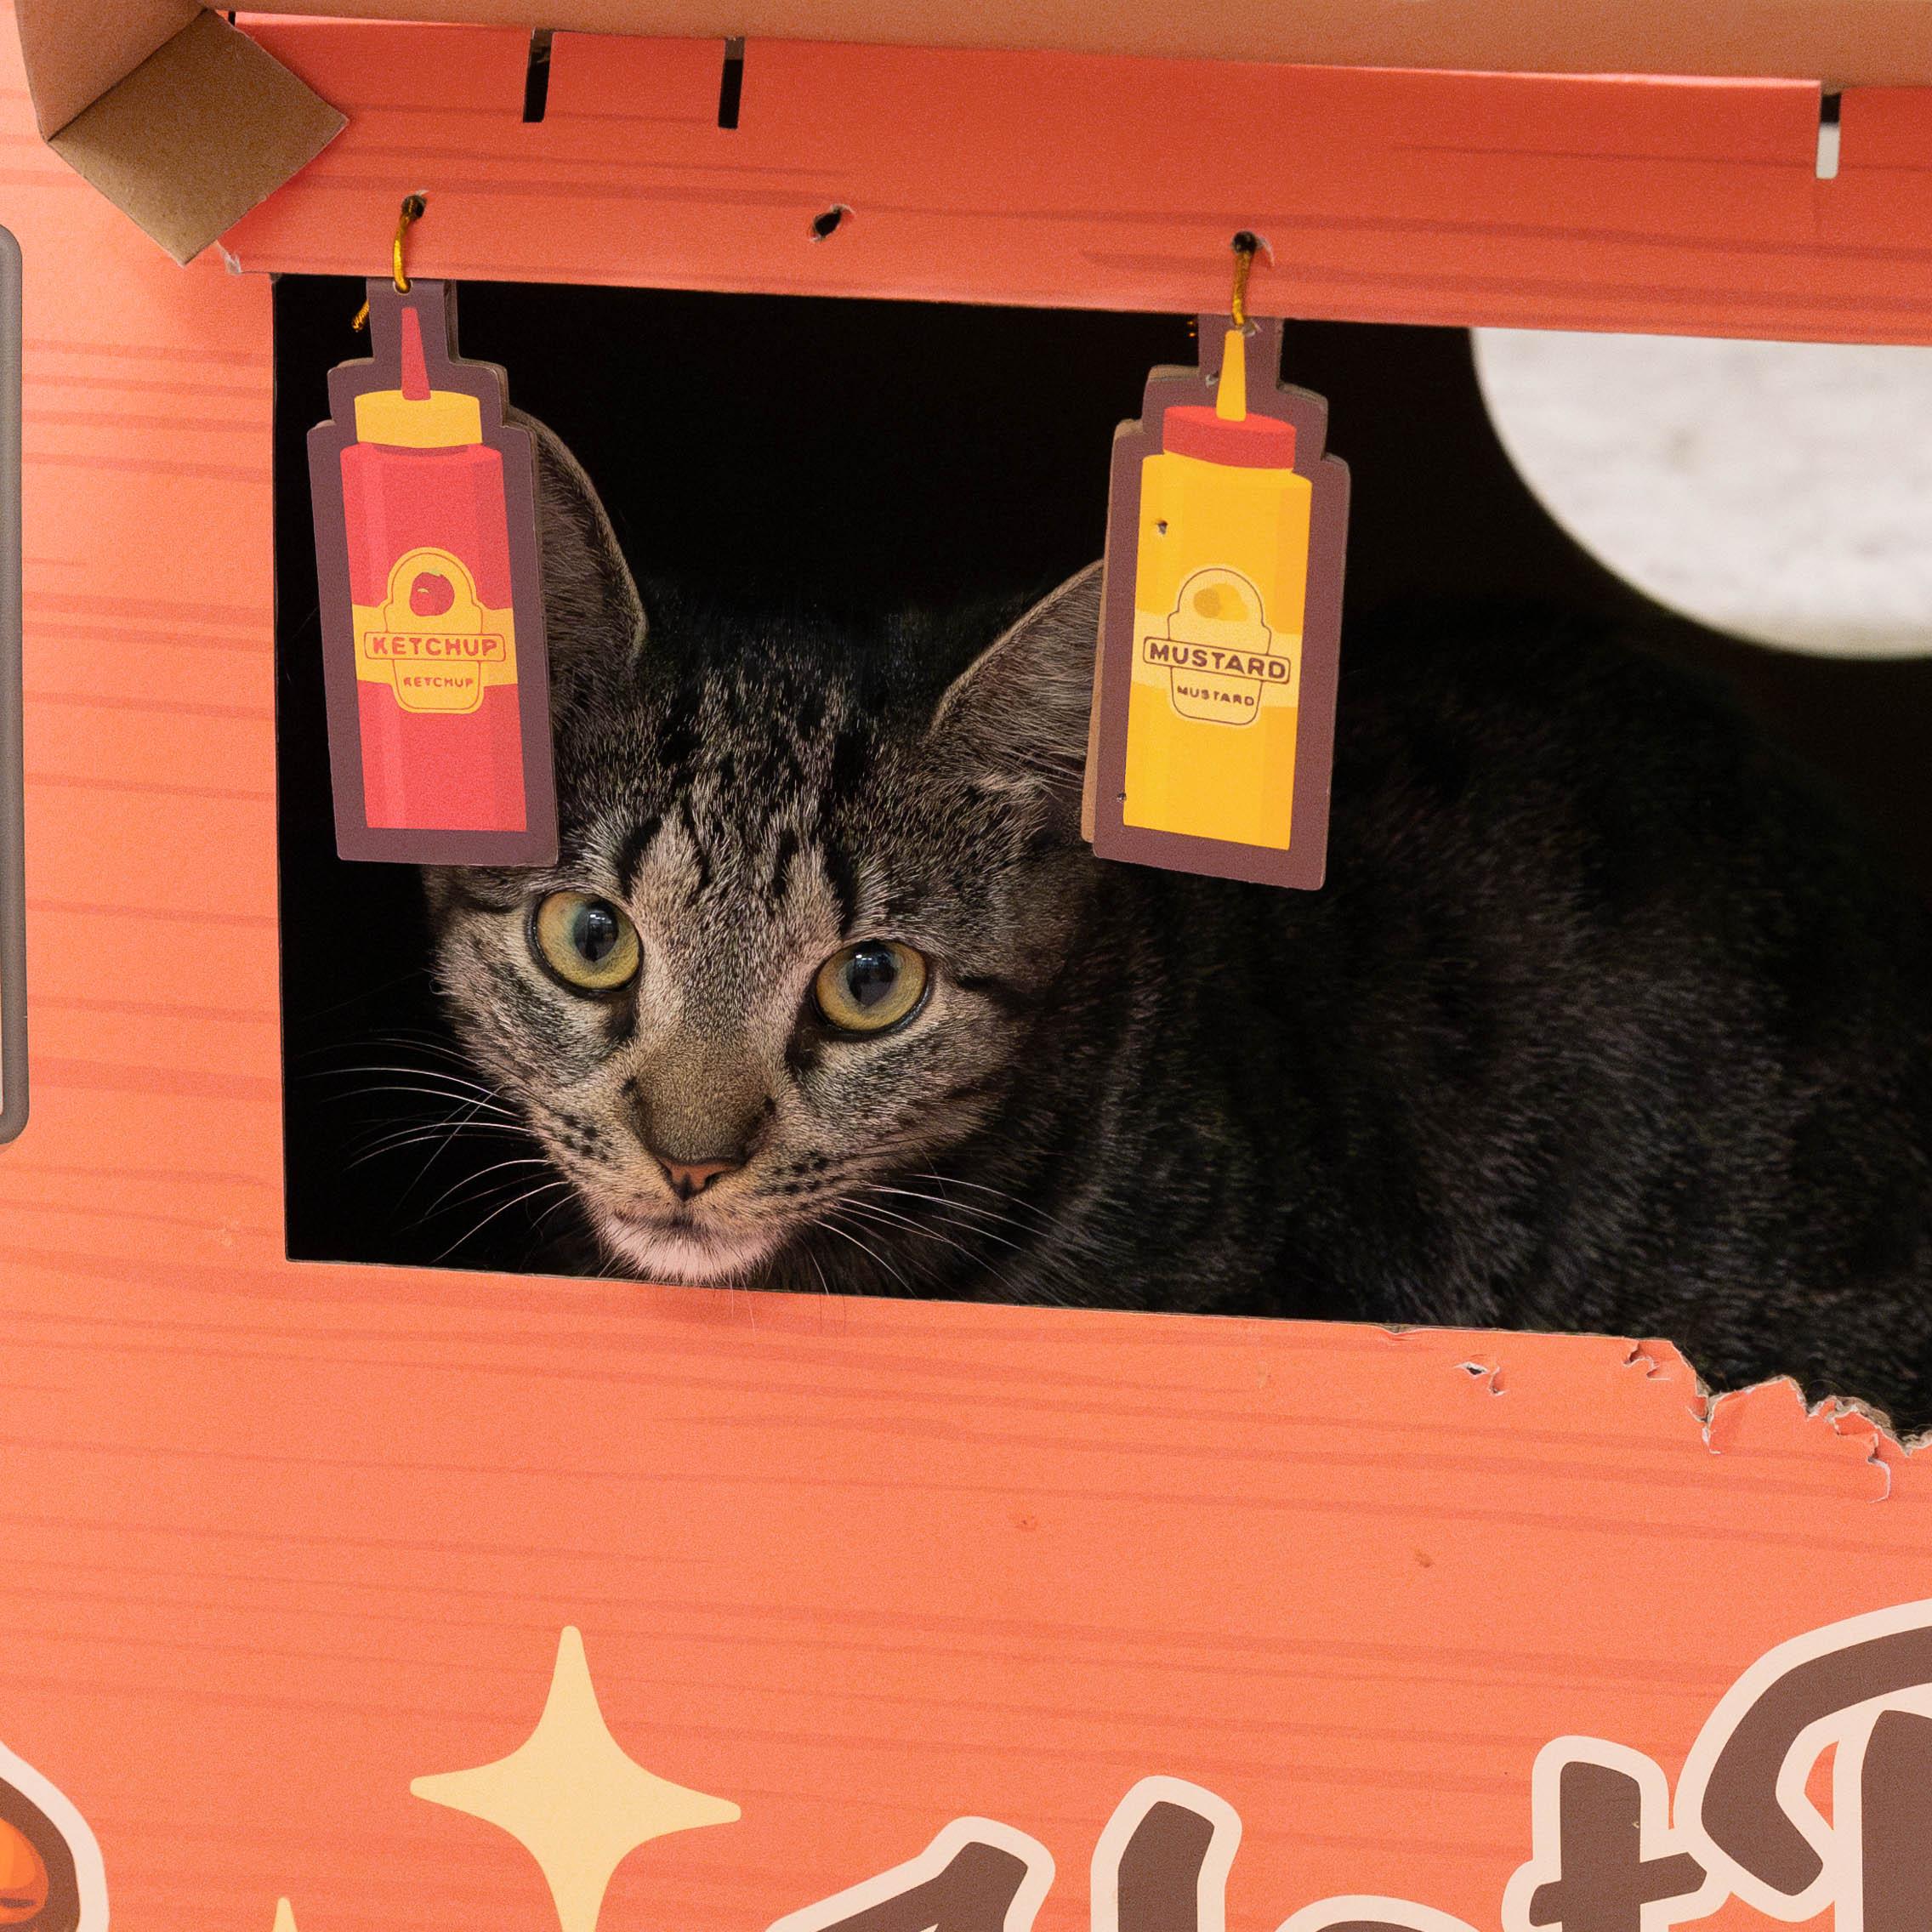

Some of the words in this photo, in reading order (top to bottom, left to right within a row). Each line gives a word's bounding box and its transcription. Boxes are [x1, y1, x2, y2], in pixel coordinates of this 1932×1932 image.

[372, 637, 497, 656] KETCHUP
[1150, 642, 1285, 679] MUSTARD
[403, 676, 474, 688] KETCHUP
[1177, 685, 1255, 707] MUSTARD
